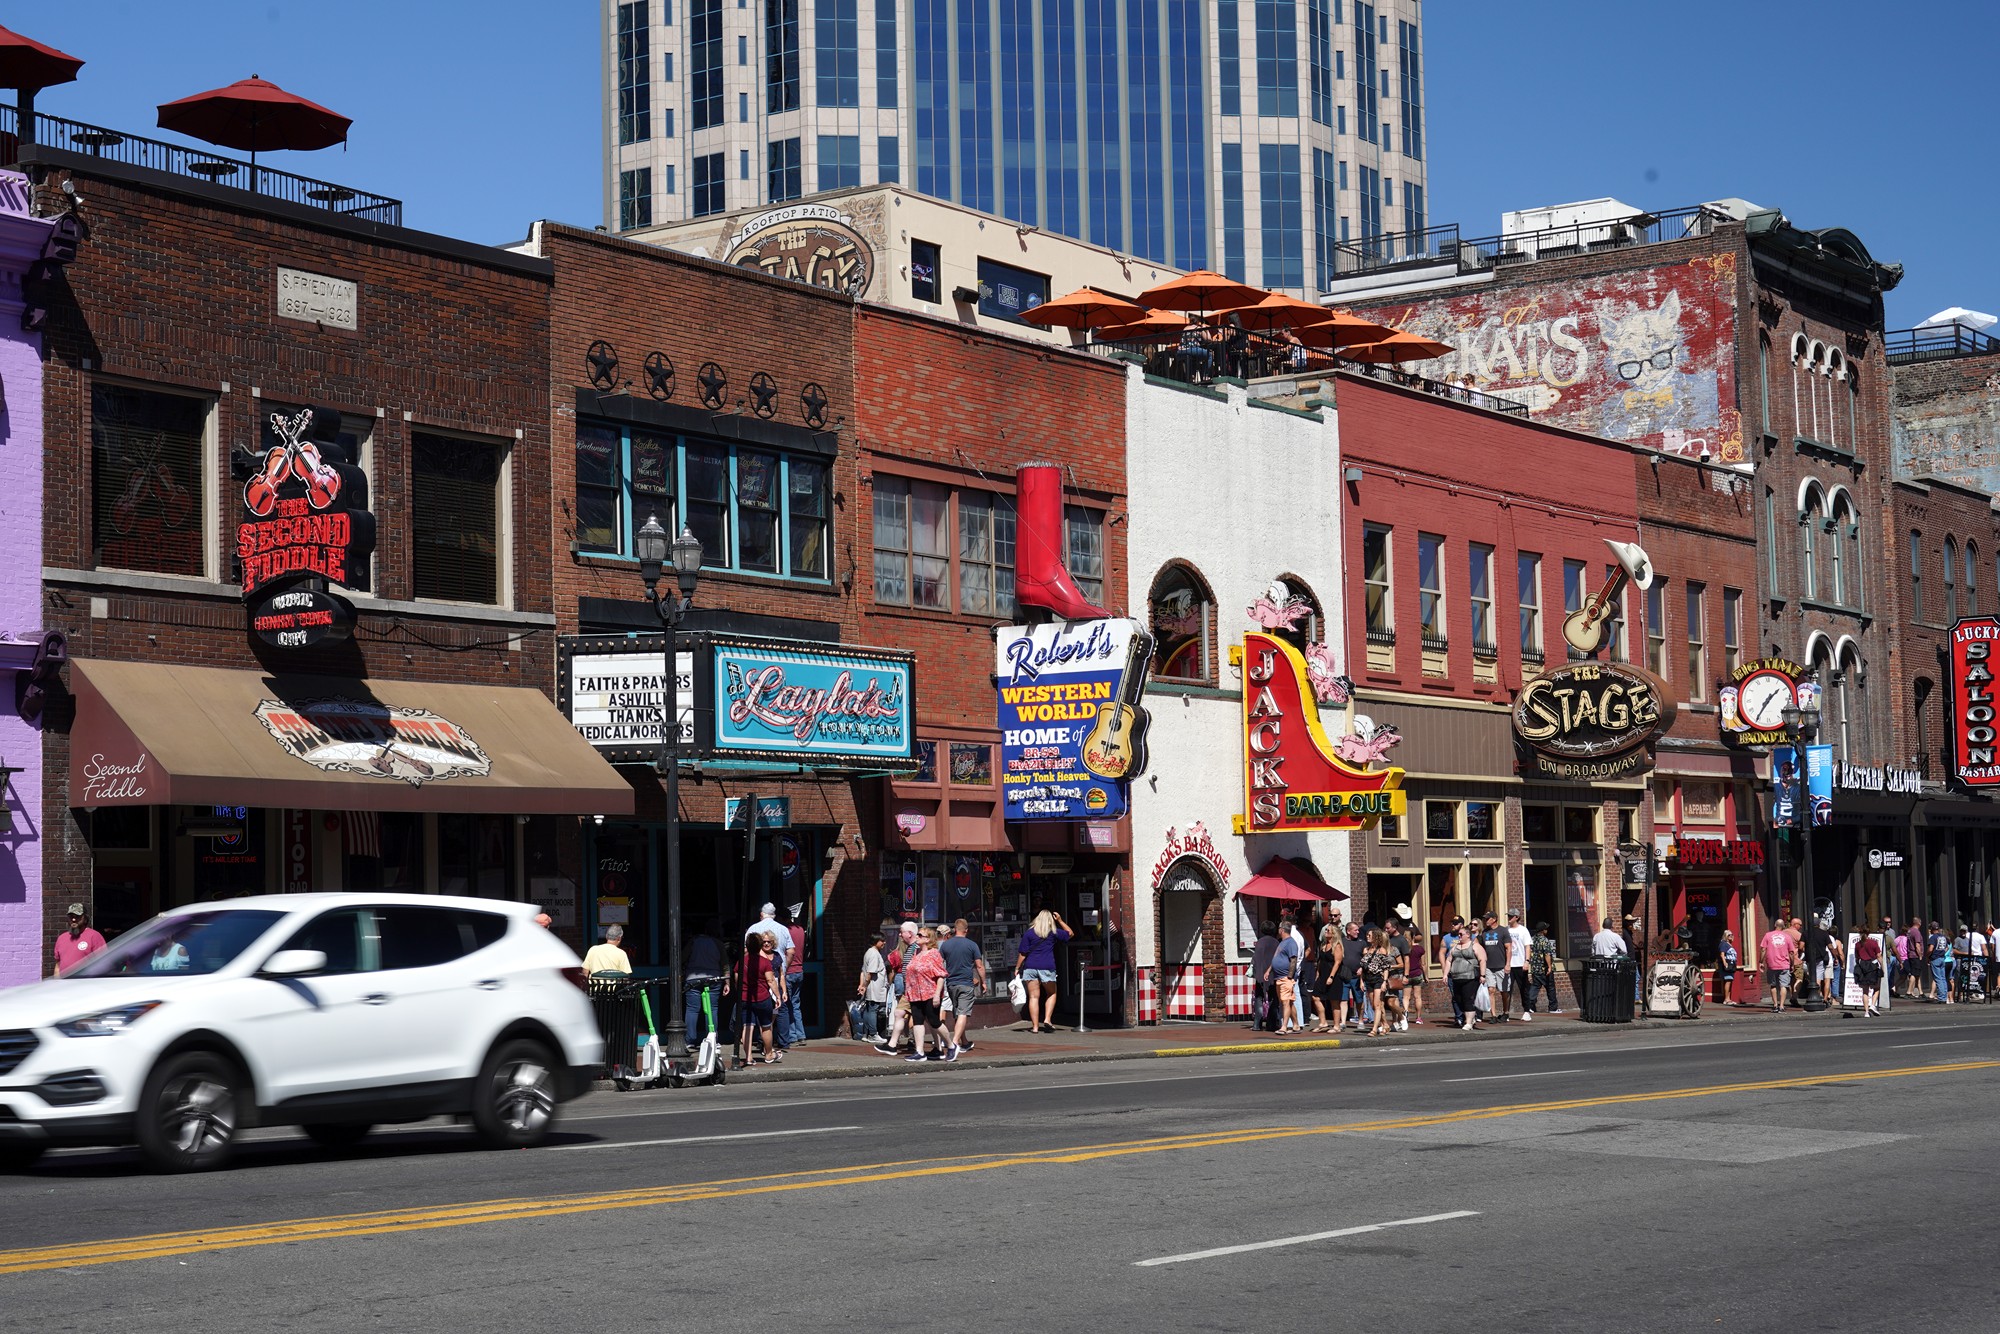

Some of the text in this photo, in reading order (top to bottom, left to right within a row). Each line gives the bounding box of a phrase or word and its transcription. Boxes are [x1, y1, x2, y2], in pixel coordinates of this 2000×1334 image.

[744, 205, 838, 236] ROOFTOP PATIO
[778, 229, 807, 251] THE
[294, 275, 352, 300] FRIEDMAN
[276, 498, 309, 517] THE
[237, 513, 350, 557] SECOND
[241, 545, 346, 593] FIDDLE
[1954, 626, 2000, 643] LUCKY
[1006, 622, 1114, 685] Robert's
[1571, 666, 1600, 681] THE
[1732, 657, 1803, 681] BIG TIME
[580, 675, 691, 690] FAITH & PRAYRS
[1001, 681, 1112, 704] WESTERN
[730, 665, 898, 739] Layla's
[1016, 702, 1097, 723] WORLD
[1522, 679, 1657, 740] STAGE
[1965, 642, 1995, 764] SALOON
[608, 709, 662, 723] THANKS
[267, 712, 483, 764] SECOND FIDDLE
[1005, 725, 1086, 746] HOME of
[1249, 648, 1288, 826] JACKS
[1738, 730, 1800, 745] BOOT
[84, 753, 145, 778] Second
[1539, 755, 1640, 776] ON BROADWAY
[1808, 749, 1820, 777] WOODS
[83, 776, 146, 801] Fiddle
[1003, 771, 1090, 785] Honky Tonk Heaven
[1841, 760, 1884, 791] BASTARD
[1886, 765, 1922, 794] SALOON
[1286, 792, 1391, 817] BAR-B-QUE
[1688, 803, 1713, 815] APPAREL
[1151, 838, 1182, 888] JACK'S
[1680, 838, 1764, 865] BOOTS HATS
[600, 858, 630, 872] Tito's
